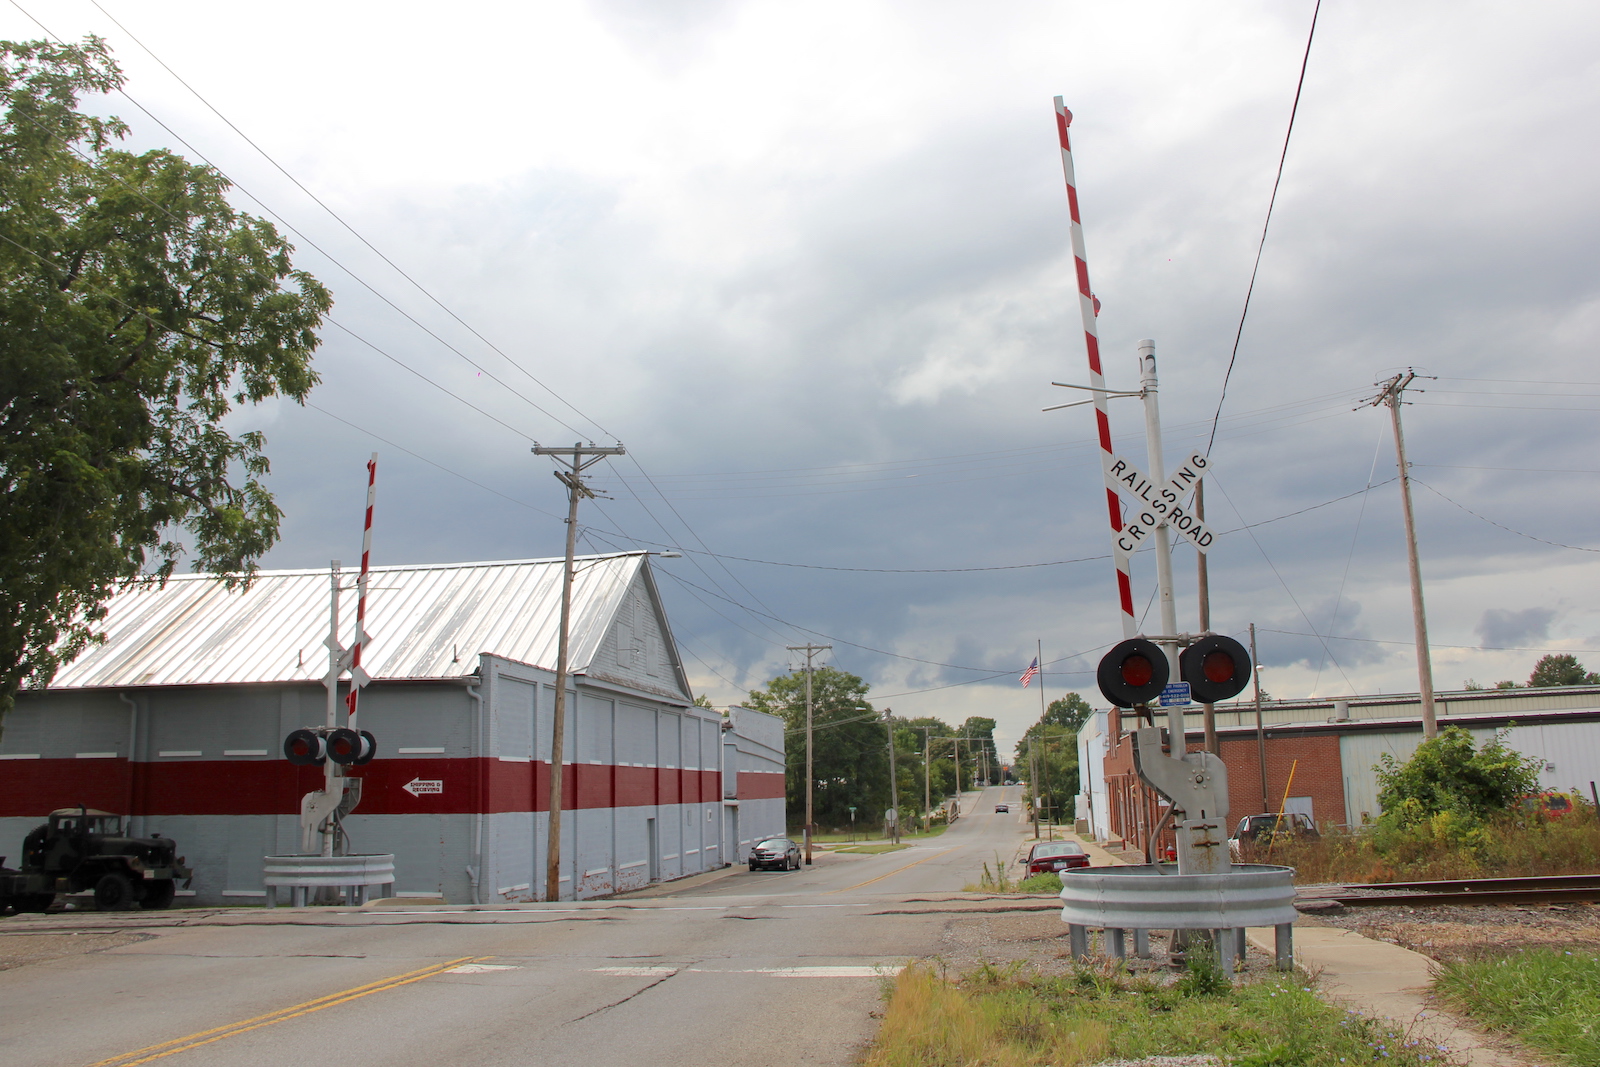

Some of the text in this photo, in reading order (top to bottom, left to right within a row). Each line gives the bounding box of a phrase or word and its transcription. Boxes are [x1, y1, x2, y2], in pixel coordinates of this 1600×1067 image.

[1111, 460, 1213, 547] RAIL ROAD
[1118, 455, 1207, 552] CROSSING
